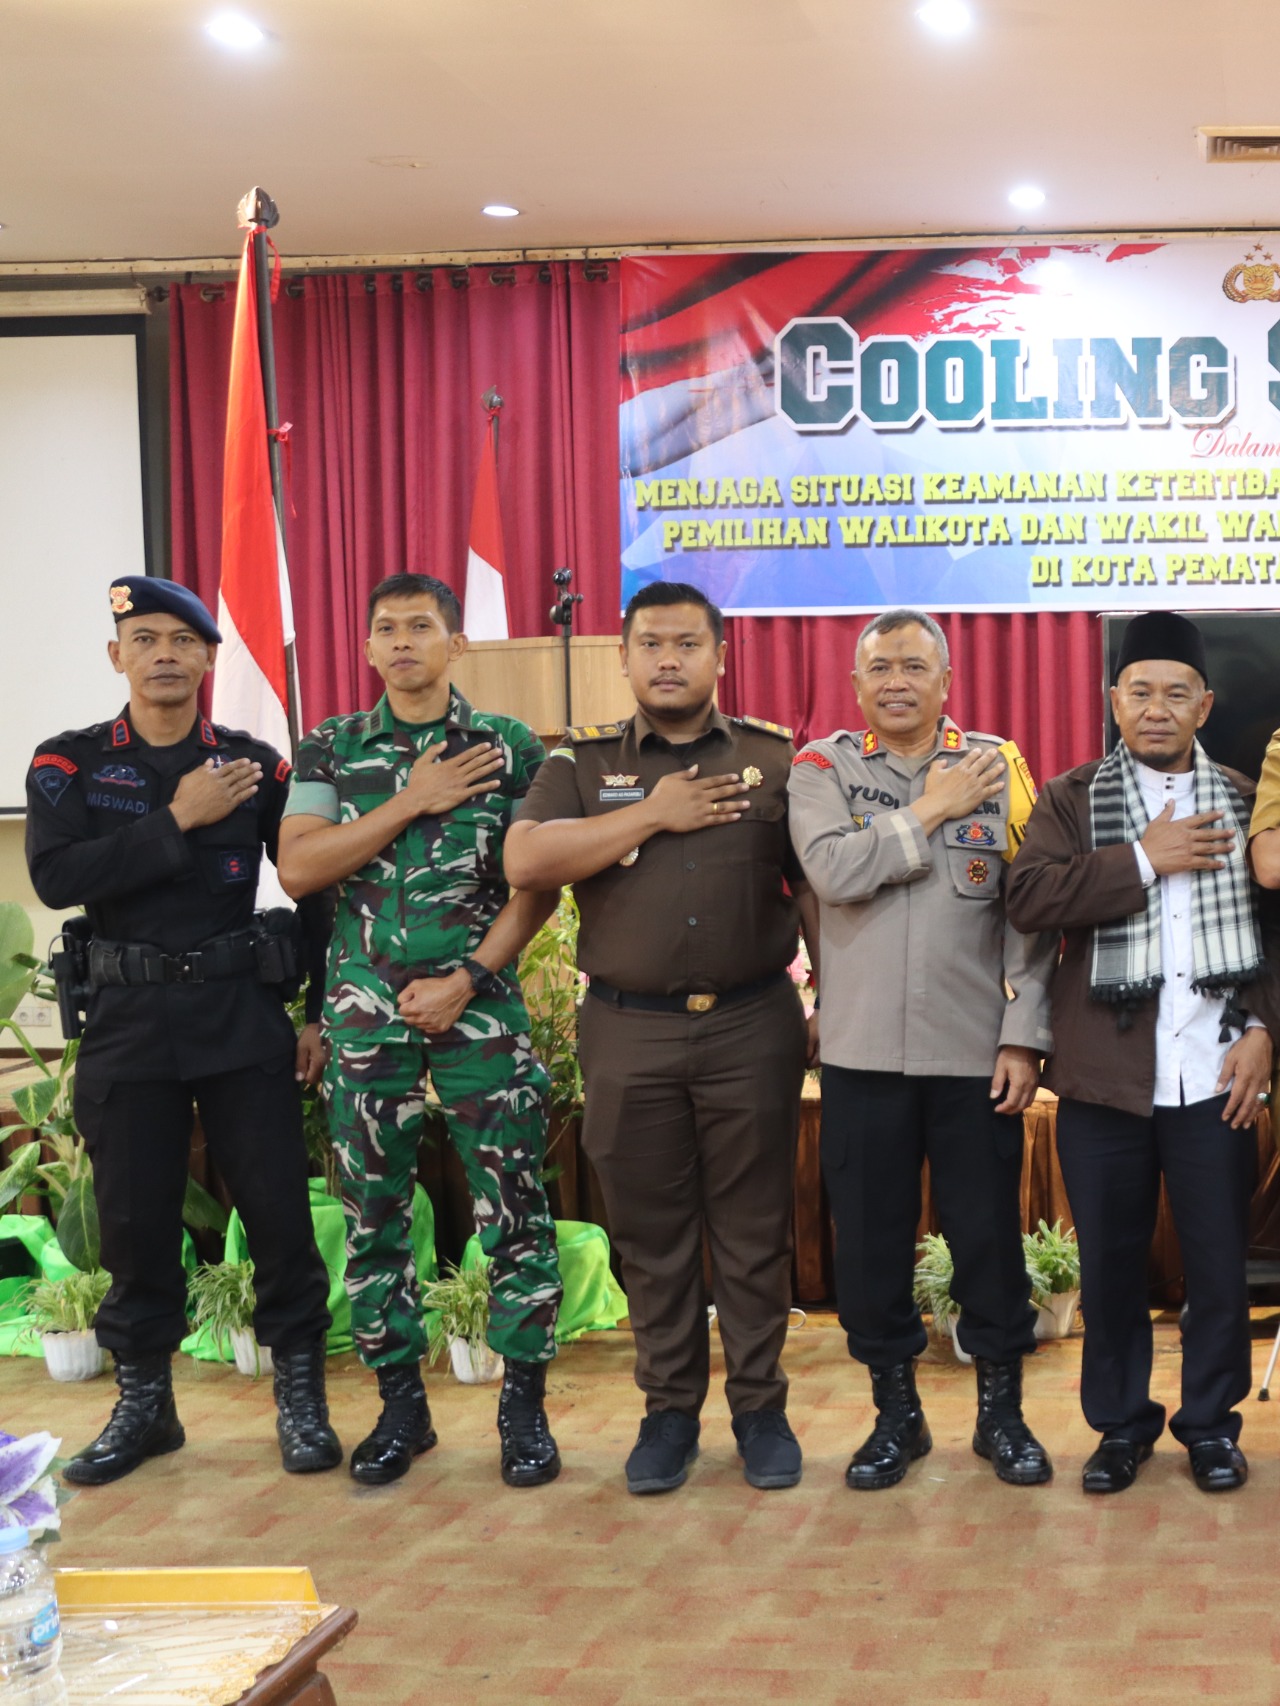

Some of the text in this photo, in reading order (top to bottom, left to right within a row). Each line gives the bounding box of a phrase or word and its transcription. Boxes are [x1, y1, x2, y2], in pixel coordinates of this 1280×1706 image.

[635, 476, 781, 509] MENJAGA
[791, 474, 913, 505] SITUASI
[923, 472, 1106, 503] KEAMANAN
[663, 516, 829, 549] PEMILIHAN
[838, 514, 1010, 545] WALIKOTA
[1020, 513, 1085, 543] DAN
[1097, 511, 1208, 541] WAKIL
[1031, 555, 1062, 585] DI
[1071, 554, 1158, 584] KOTA
[86, 791, 150, 815] MISWADI
[848, 783, 900, 810] YUDI
